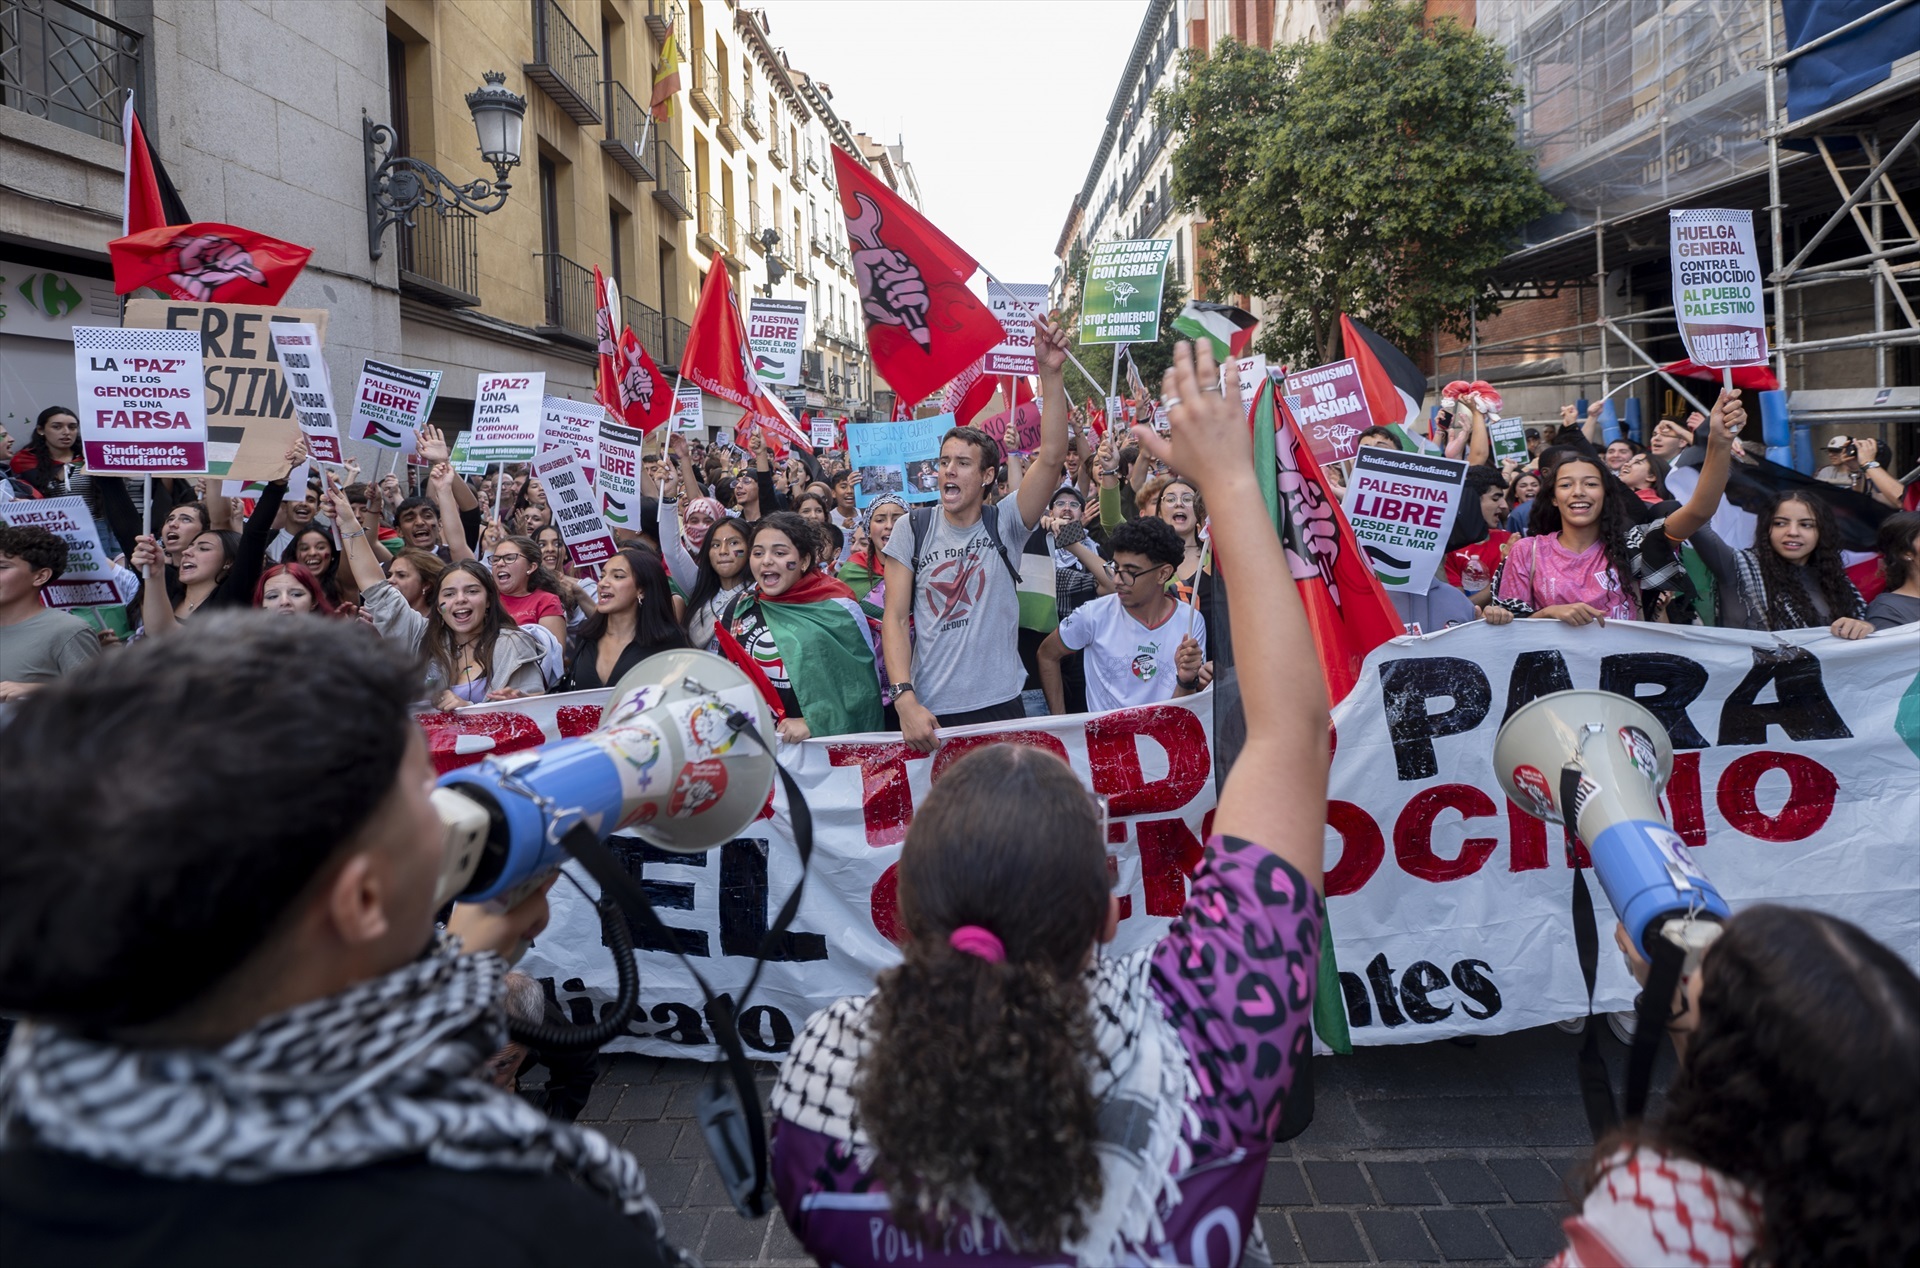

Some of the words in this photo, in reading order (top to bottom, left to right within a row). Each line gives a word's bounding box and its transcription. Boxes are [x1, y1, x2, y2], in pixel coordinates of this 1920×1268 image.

[1677, 225, 1736, 240] HUELGA
[1097, 241, 1151, 254] RUPTURA
[1152, 241, 1170, 250] DE
[1678, 242, 1744, 257] GENERAL
[1093, 251, 1165, 266] RELACIONES
[1680, 260, 1727, 272] CONTRA
[1730, 259, 1740, 269] EL
[1092, 266, 1117, 279] CON
[1118, 263, 1158, 278] ISRAEL
[1681, 270, 1756, 286] GENOCIDIO
[1683, 289, 1701, 302] AL
[1702, 286, 1751, 300] PUEBLO
[993, 301, 1006, 310] LA
[1684, 301, 1756, 316] PALESTINO
[752, 315, 799, 325] PALESTINA
[999, 319, 1035, 327] ENOCIDA
[1084, 314, 1106, 325] STOP
[1108, 311, 1155, 324] COMERCIO
[750, 325, 798, 340] LIBRE
[1096, 326, 1107, 337] DE
[1108, 324, 1140, 336] ARMAS
[1692, 333, 1746, 350] IZQUIERDA
[91, 357, 119, 372] LA
[993, 355, 1024, 364] Sindicato
[993, 362, 1034, 372] Estudiantes
[692, 367, 742, 402] Sindicato
[1290, 378, 1302, 390] EL
[1302, 364, 1353, 386] SIONISMO
[94, 386, 190, 399] GENOCIDAS
[365, 378, 421, 400] PALESTINA
[482, 379, 530, 392] ¿PAZ?
[1312, 383, 1337, 403] NO
[362, 388, 419, 414] LIBRE
[481, 392, 506, 402] UNA
[361, 402, 388, 414] DESDE
[401, 413, 415, 421] RIO
[480, 404, 519, 414] FARSA
[1301, 391, 1362, 425] PASARÁ
[96, 410, 192, 429] FARSA
[360, 409, 384, 420] HASTA
[397, 419, 414, 428] MAR
[546, 413, 560, 422] LA
[984, 417, 1006, 436] NO
[1016, 408, 1027, 426] al
[476, 424, 519, 432] CORONAR
[856, 428, 869, 444] NO
[873, 426, 887, 441] ES
[906, 420, 934, 438] GUERRA
[545, 429, 594, 443] GENOCIDAS
[103, 444, 166, 456] Sindicato
[168, 446, 186, 456] de
[600, 442, 635, 459] PALESTINA
[870, 444, 880, 456] ES
[886, 443, 898, 456] UN
[901, 438, 934, 453] GENOCIDIO
[104, 455, 188, 466] Estudiantes
[600, 453, 635, 477] LIBRE
[1362, 455, 1399, 468] Sindicato
[1399, 462, 1409, 470] de
[1408, 463, 1457, 478] Estudiantes
[549, 471, 576, 490] PARARLO
[600, 471, 613, 482] DESDE
[614, 476, 621, 484] EL
[623, 478, 635, 487] RIO
[599, 479, 611, 489] HASTA
[620, 486, 635, 495] MAR
[1358, 477, 1448, 504] PALESTINA
[559, 488, 578, 504] TODO
[10, 510, 68, 524] HUELGA
[557, 506, 574, 522] PARA
[573, 501, 595, 519] PARAR
[1353, 494, 1446, 529] LIBRE
[562, 525, 571, 538] EL
[570, 517, 603, 536] GENOCIDIO
[1351, 518, 1394, 533] DESDE
[1396, 526, 1411, 536] EL
[1414, 529, 1438, 541] RIO
[1389, 536, 1404, 546] EL
[1406, 539, 1436, 551] MAR
[945, 548, 964, 558] FOR
[951, 618, 968, 629] DUTY
[1138, 645, 1155, 654] PUMA
